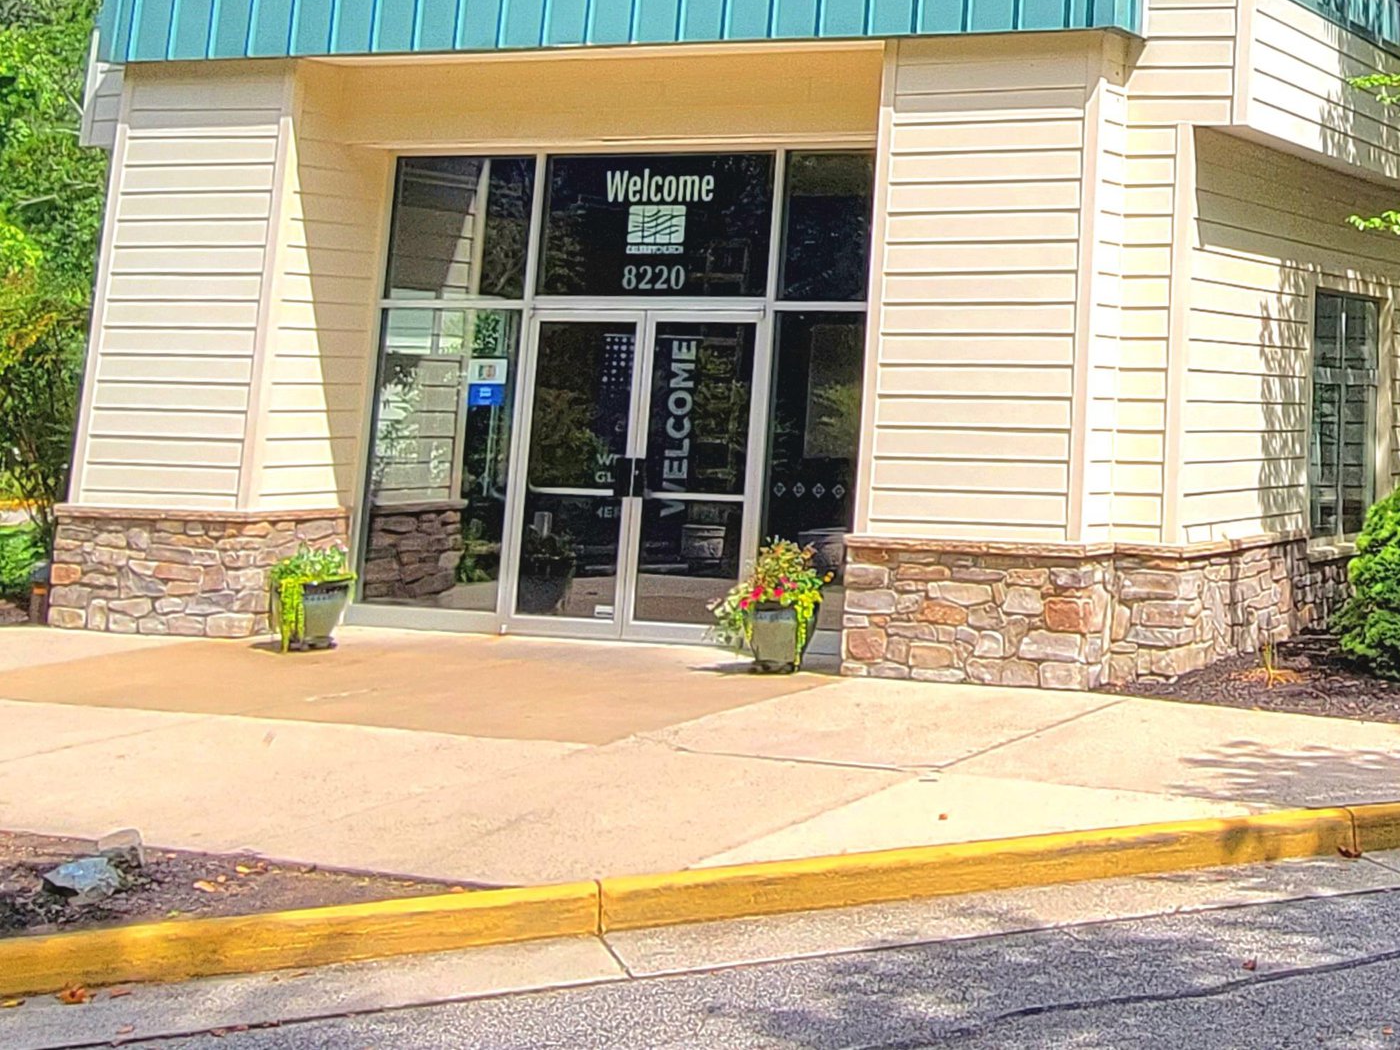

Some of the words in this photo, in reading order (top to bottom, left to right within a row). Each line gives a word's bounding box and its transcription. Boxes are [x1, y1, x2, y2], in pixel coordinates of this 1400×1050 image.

[606, 168, 715, 203] Welcome
[622, 265, 686, 290] 8220
[660, 340, 697, 518] WELCOME
